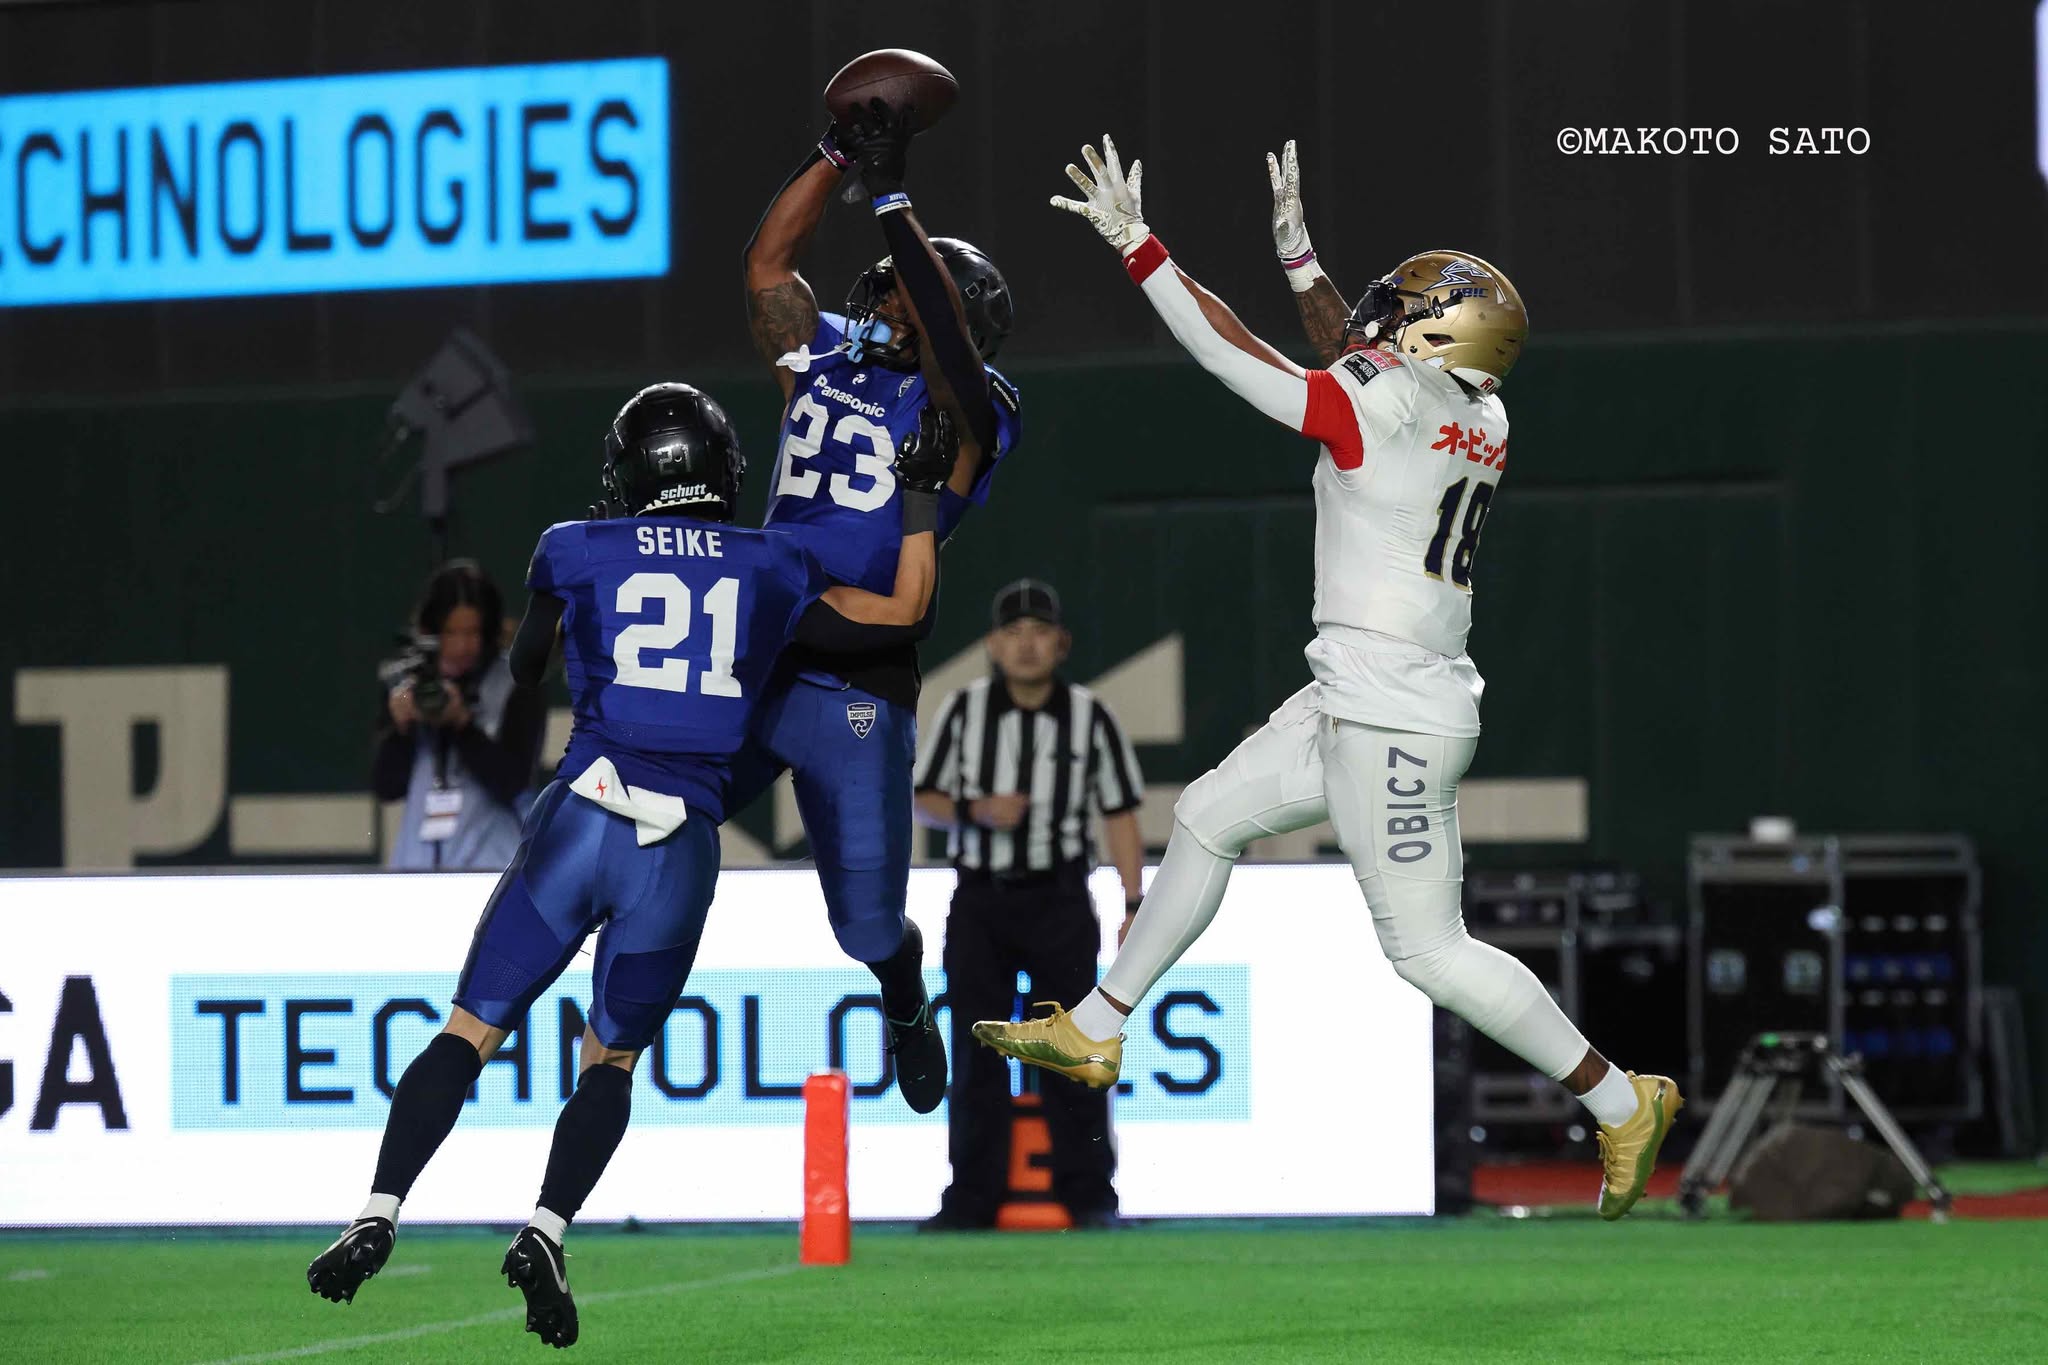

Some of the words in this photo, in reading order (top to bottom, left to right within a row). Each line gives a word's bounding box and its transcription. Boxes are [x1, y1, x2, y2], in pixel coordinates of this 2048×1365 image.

[0, 100, 640, 265] CHNOLOGIES
[776, 393, 896, 512] 23
[814, 374, 886, 418] Panasonic
[636, 526, 723, 557] SEIKE
[660, 483, 707, 500] schutt
[1424, 476, 1496, 592] 18
[613, 573, 743, 698] 21
[0, 975, 129, 1131] A
